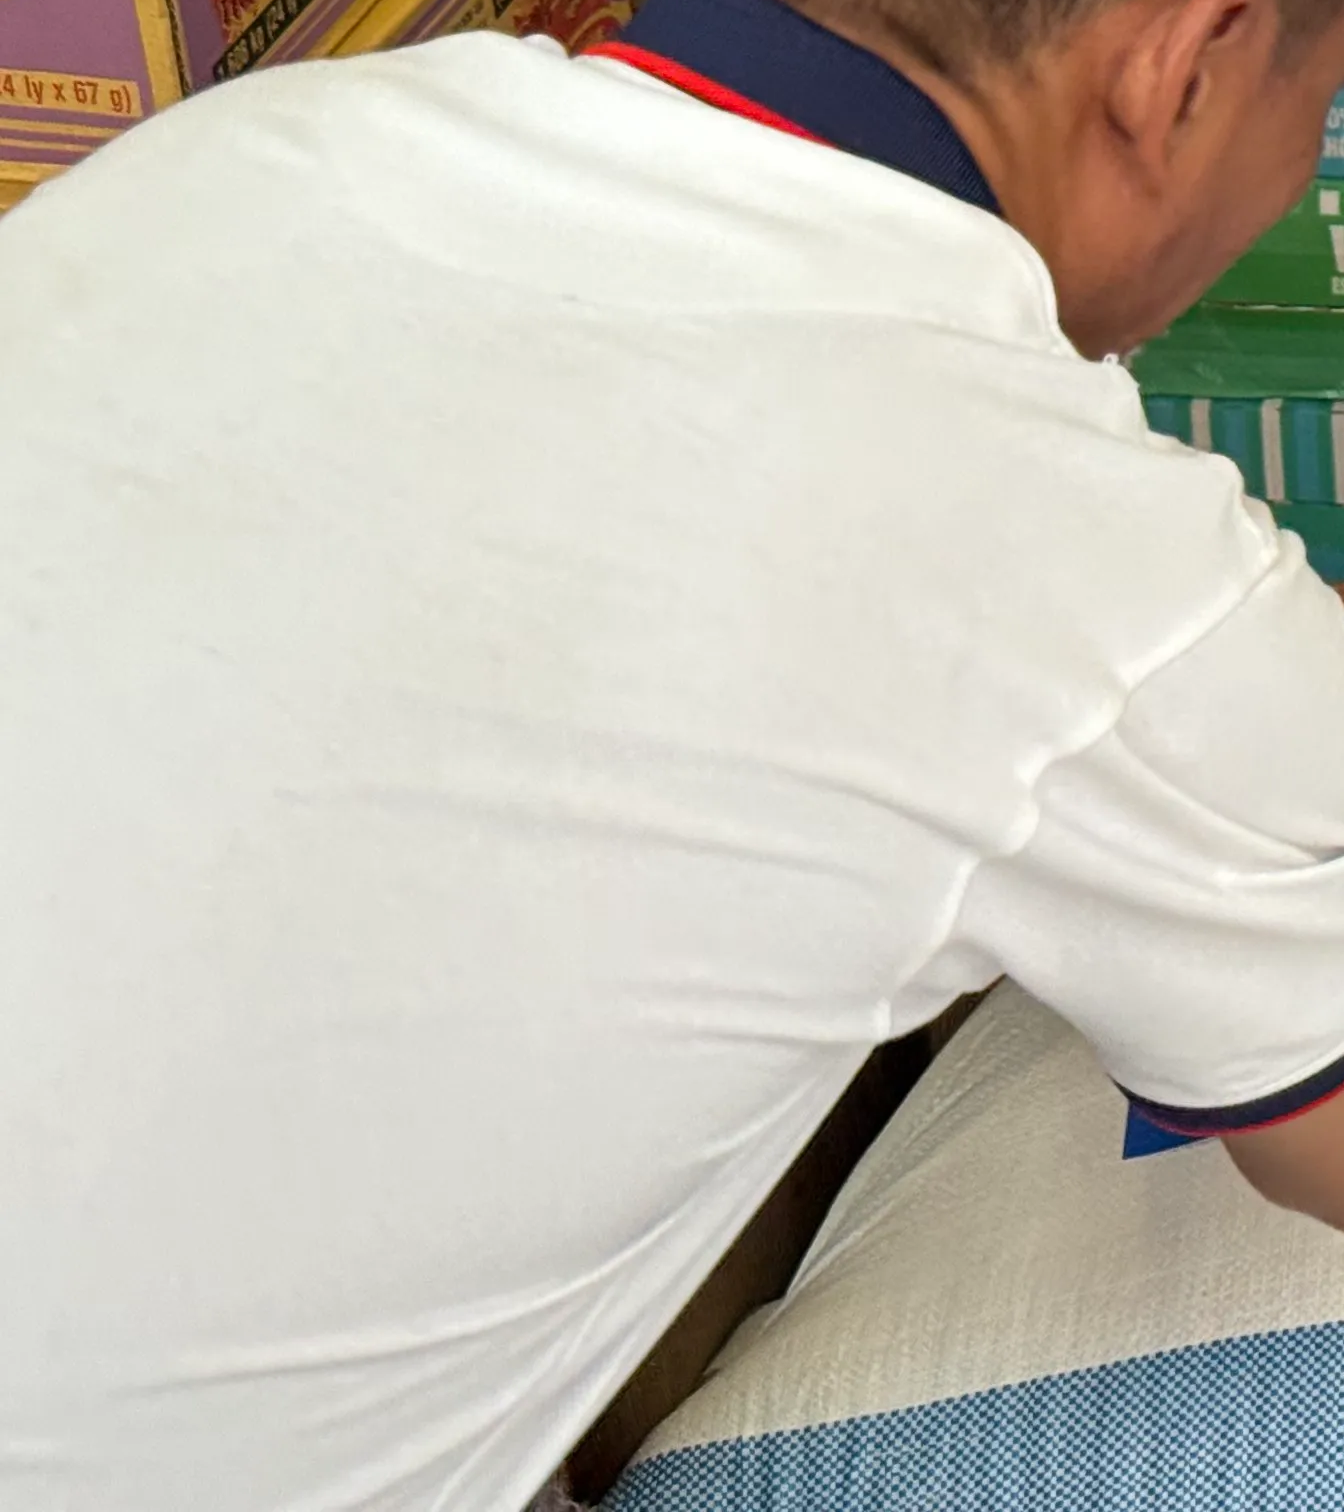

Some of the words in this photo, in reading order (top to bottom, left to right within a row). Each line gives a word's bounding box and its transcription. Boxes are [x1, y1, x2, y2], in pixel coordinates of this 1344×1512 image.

[24, 74, 44, 106] ly
[52, 82, 67, 103] x
[73, 79, 100, 106] 67
[110, 84, 132, 115] g)
